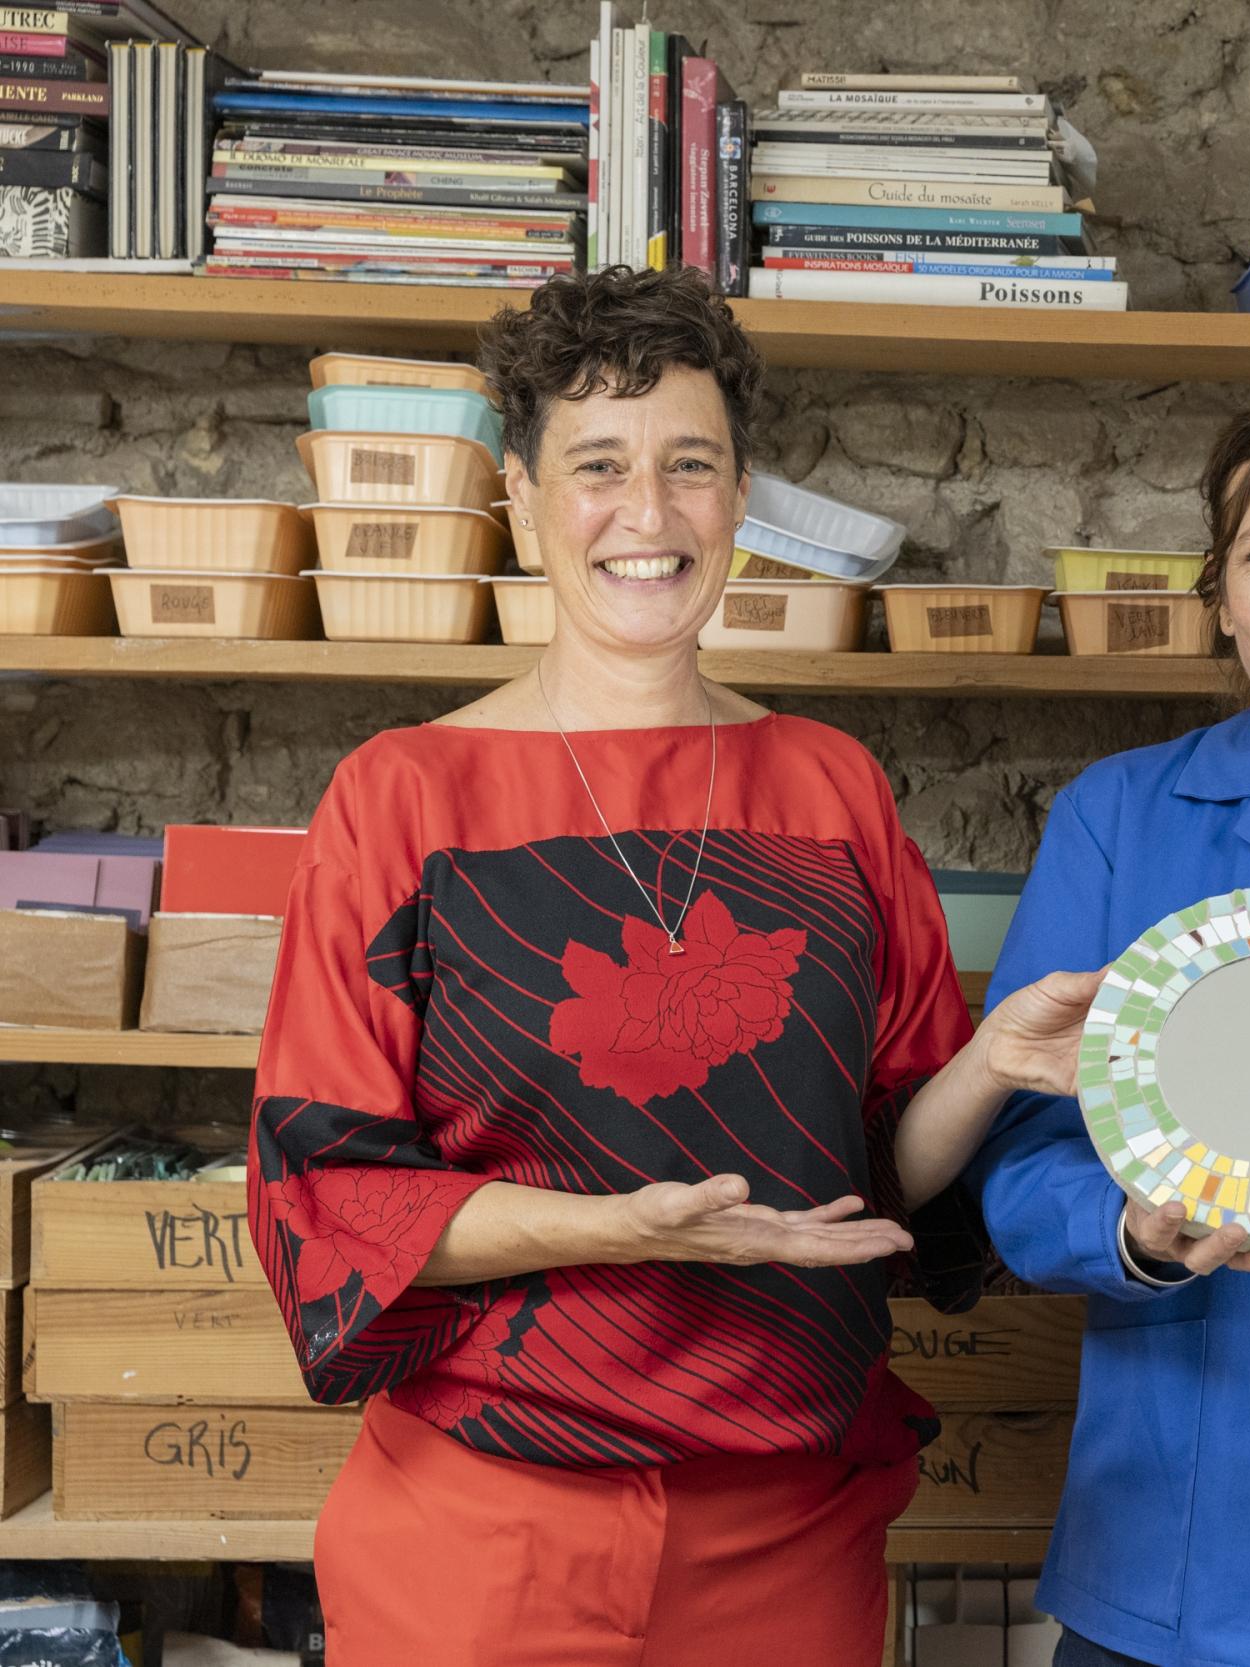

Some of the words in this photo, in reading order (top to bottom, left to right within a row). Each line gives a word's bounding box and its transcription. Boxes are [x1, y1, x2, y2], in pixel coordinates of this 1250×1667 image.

[0, 60, 35, 73] -1990
[829, 94, 842, 103] LA
[845, 92, 898, 104] MOSAÏQUE
[243, 152, 286, 162] DUOMO
[306, 155, 366, 168] MONREALE
[360, 185, 372, 197] Le
[376, 187, 424, 200] Prophète
[868, 182, 913, 201] Guide
[918, 184, 935, 202] du
[940, 193, 992, 207] mosaïste
[728, 165, 738, 240] BARCELONA
[804, 234, 828, 243] GUIDE
[830, 235, 845, 243] DES
[846, 232, 903, 245] POISSONS
[905, 234, 923, 245] DE
[925, 235, 942, 247] LA
[945, 233, 1040, 250] MÉDITERRANÉE
[788, 251, 848, 262] EYEWITNESS
[849, 252, 878, 262] BOOKS
[804, 260, 862, 271] INSPIRATIONS
[863, 261, 910, 273] MOSAÏQUE
[929, 264, 967, 275] MODÈLES
[968, 266, 1014, 277] ORIGINAUX
[1015, 268, 1040, 278] POUR
[1040, 269, 1051, 278] LA
[1052, 270, 1086, 280] MAISON
[979, 282, 1084, 305] Poissons
[161, 592, 209, 616] ROUGE
[145, 1202, 248, 1283] VERT
[174, 1311, 241, 1330] VERT
[890, 1326, 1022, 1360] OUGE
[144, 1413, 252, 1481] GRIS
[918, 1441, 983, 1495] RUN
